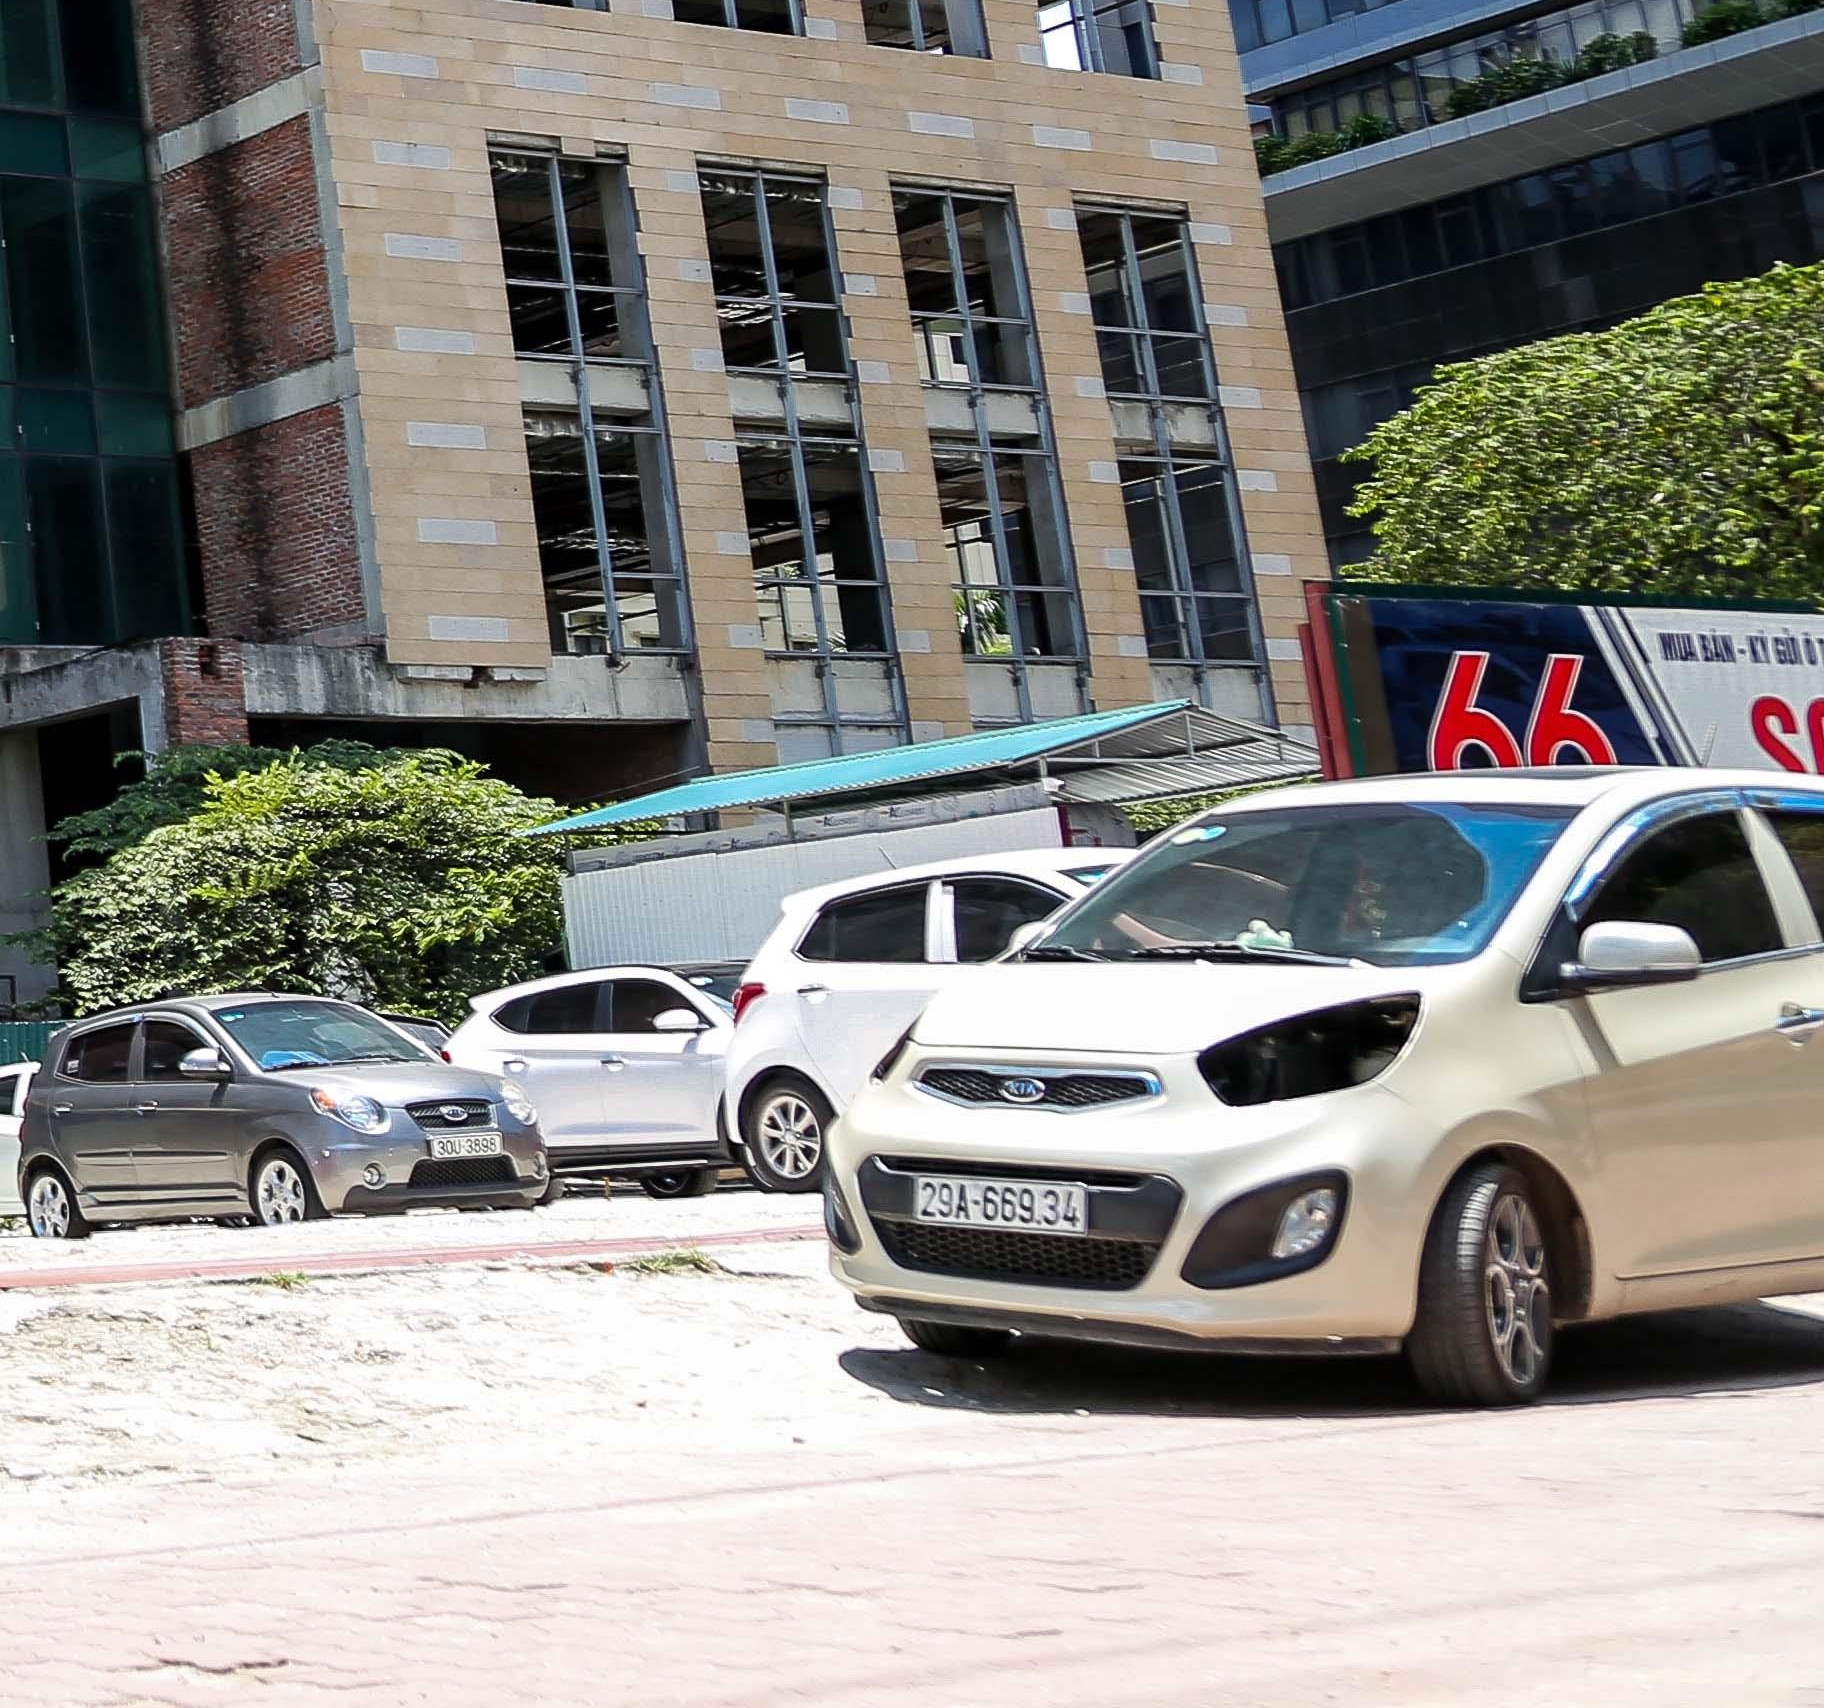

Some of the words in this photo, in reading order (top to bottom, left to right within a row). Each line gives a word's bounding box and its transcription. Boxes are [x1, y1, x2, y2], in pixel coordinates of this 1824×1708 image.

[1658, 632, 1700, 661] MUA
[1697, 628, 1736, 663] BÁN
[921, 1182, 1080, 1227] 29A-669.34
